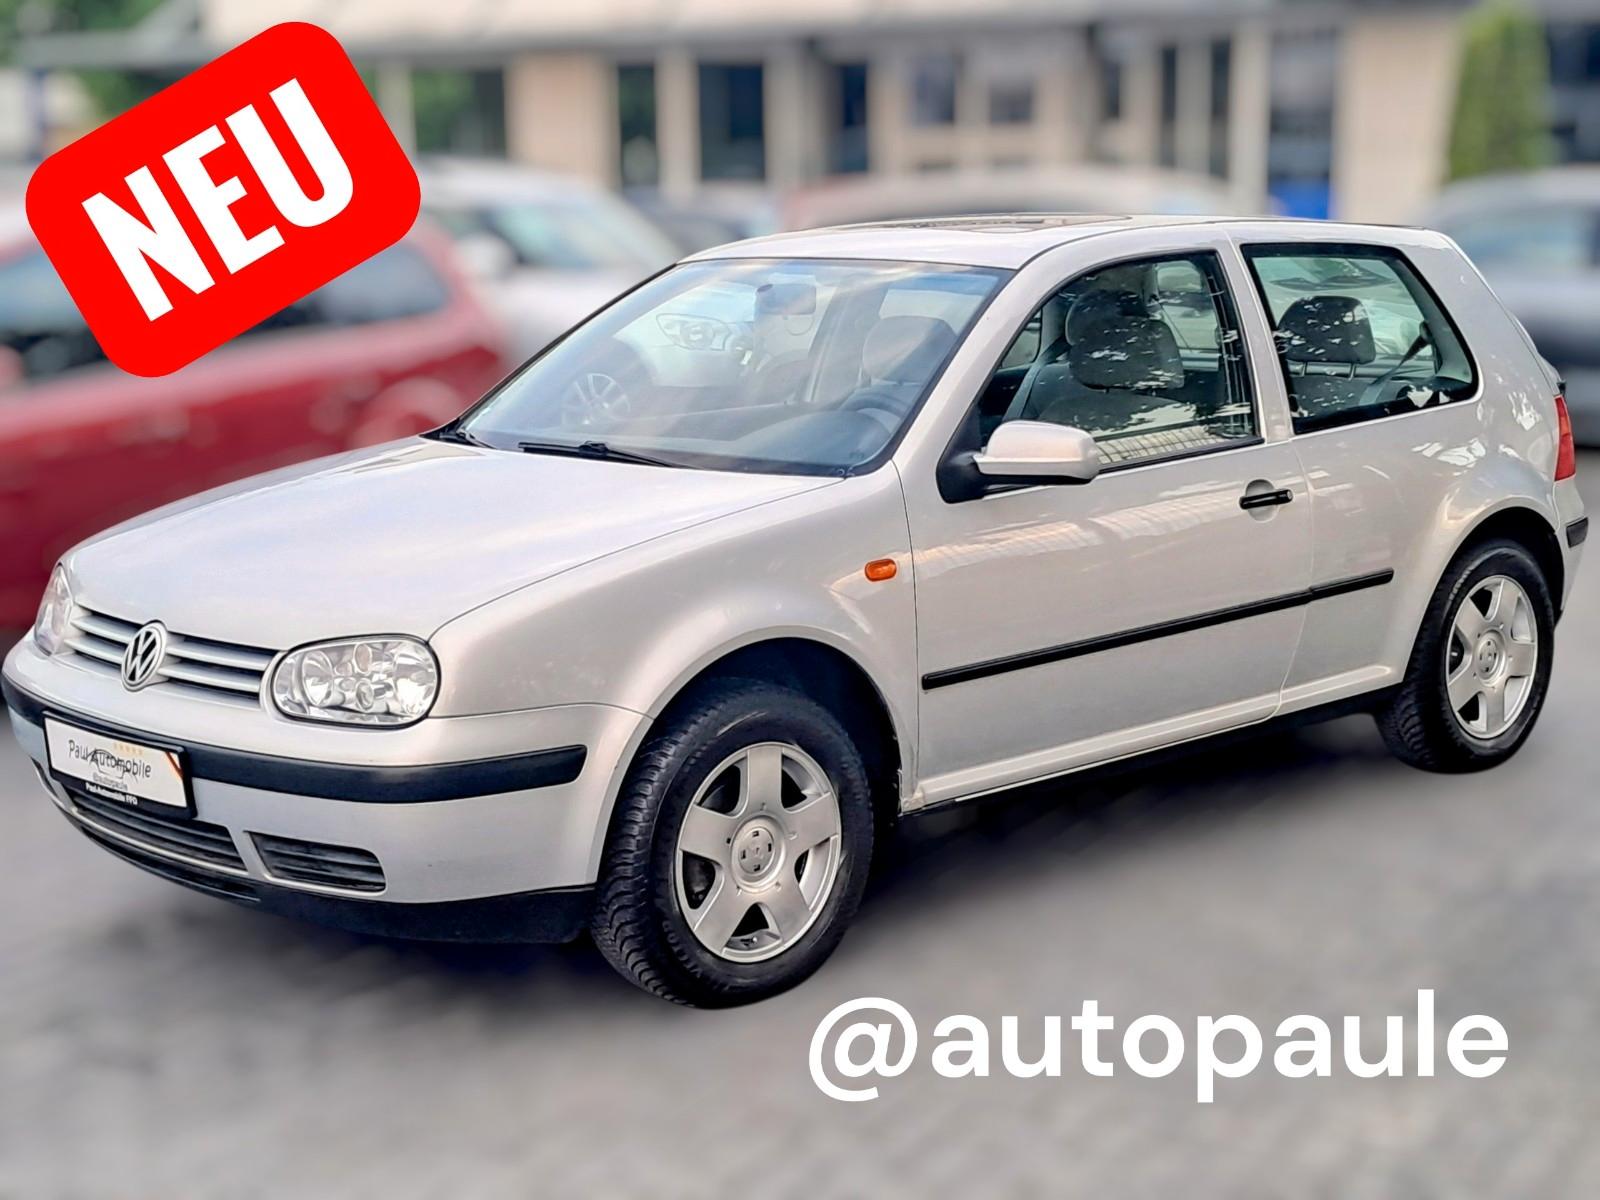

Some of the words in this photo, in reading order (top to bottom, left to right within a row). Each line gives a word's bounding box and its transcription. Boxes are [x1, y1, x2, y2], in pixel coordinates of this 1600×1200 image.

[124, 626, 160, 686] VW
[68, 739, 88, 762] Paul
[89, 748, 151, 778] Automobile
